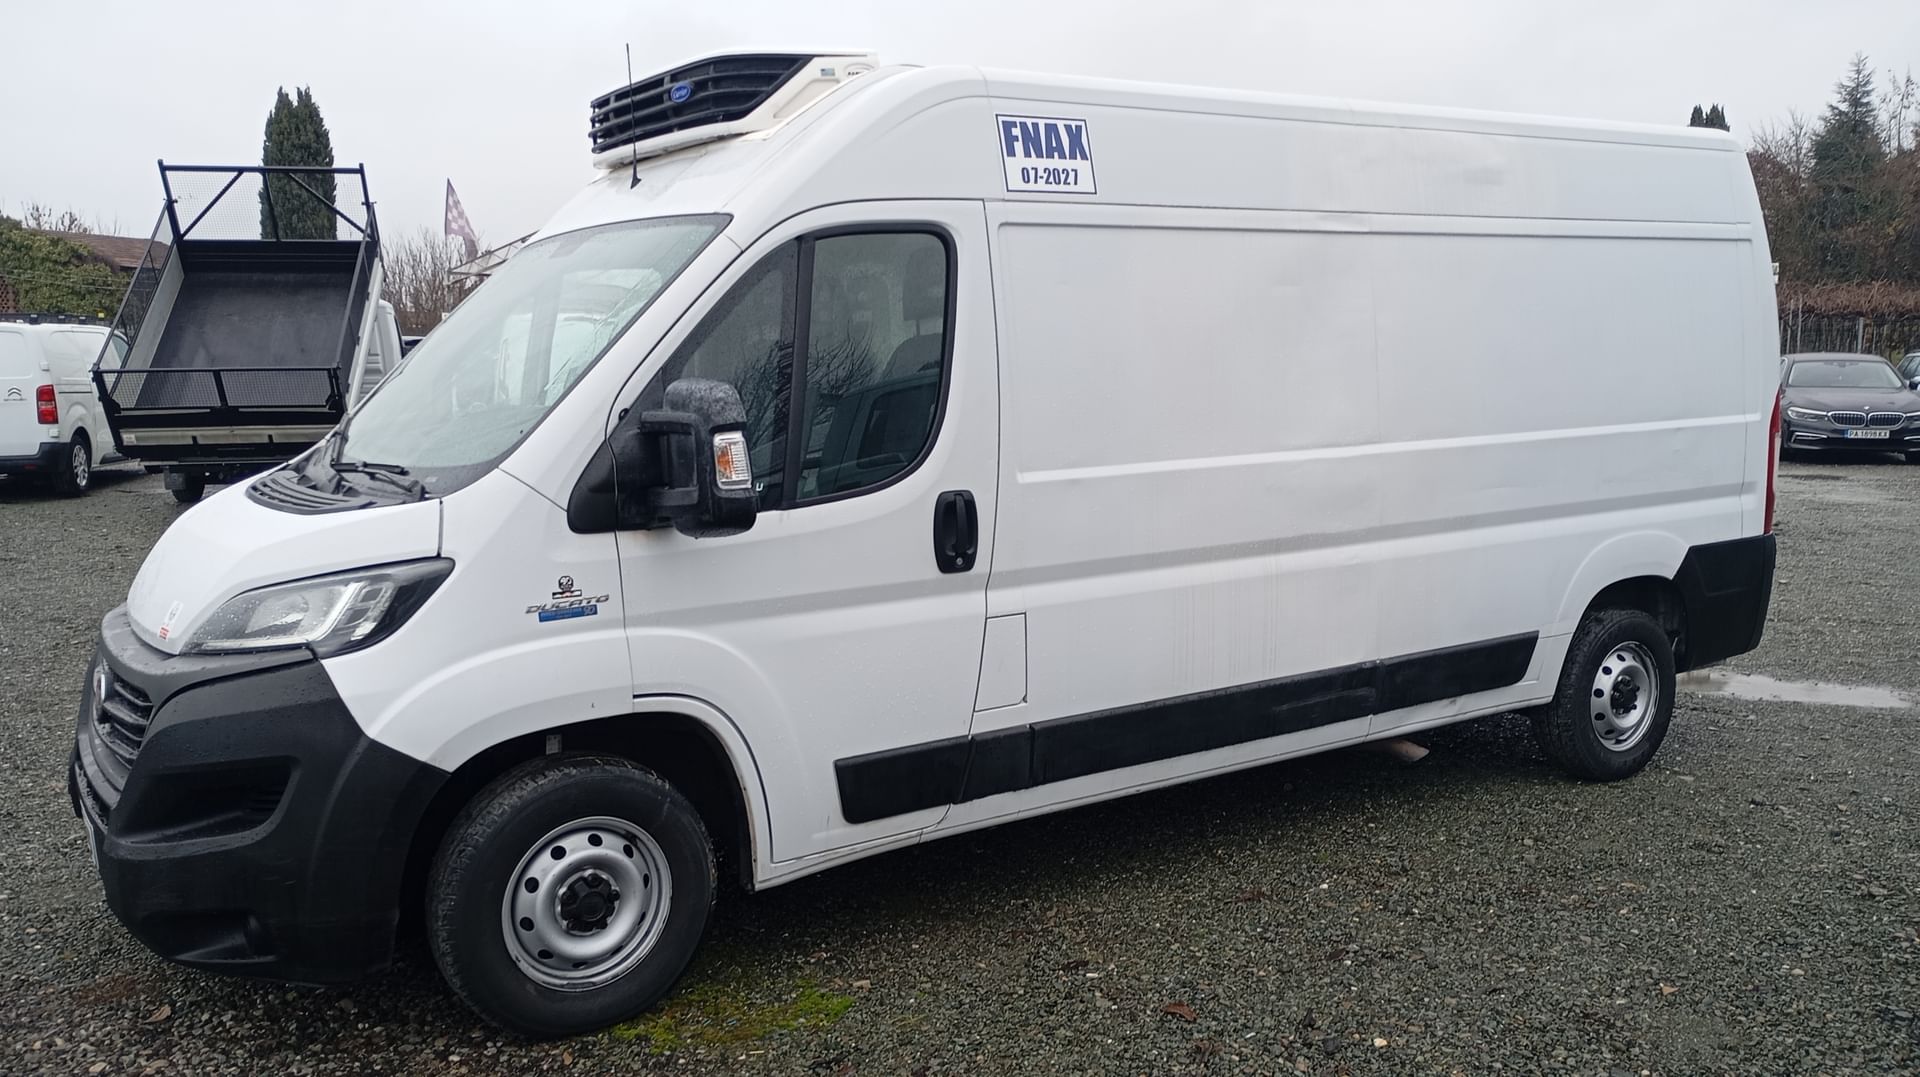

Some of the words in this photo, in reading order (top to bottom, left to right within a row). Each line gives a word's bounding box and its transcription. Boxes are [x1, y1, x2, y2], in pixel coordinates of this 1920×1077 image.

[1001, 120, 1089, 161] FNAX
[1021, 167, 1079, 185] 07-2027
[525, 594, 609, 614] DUCATO
